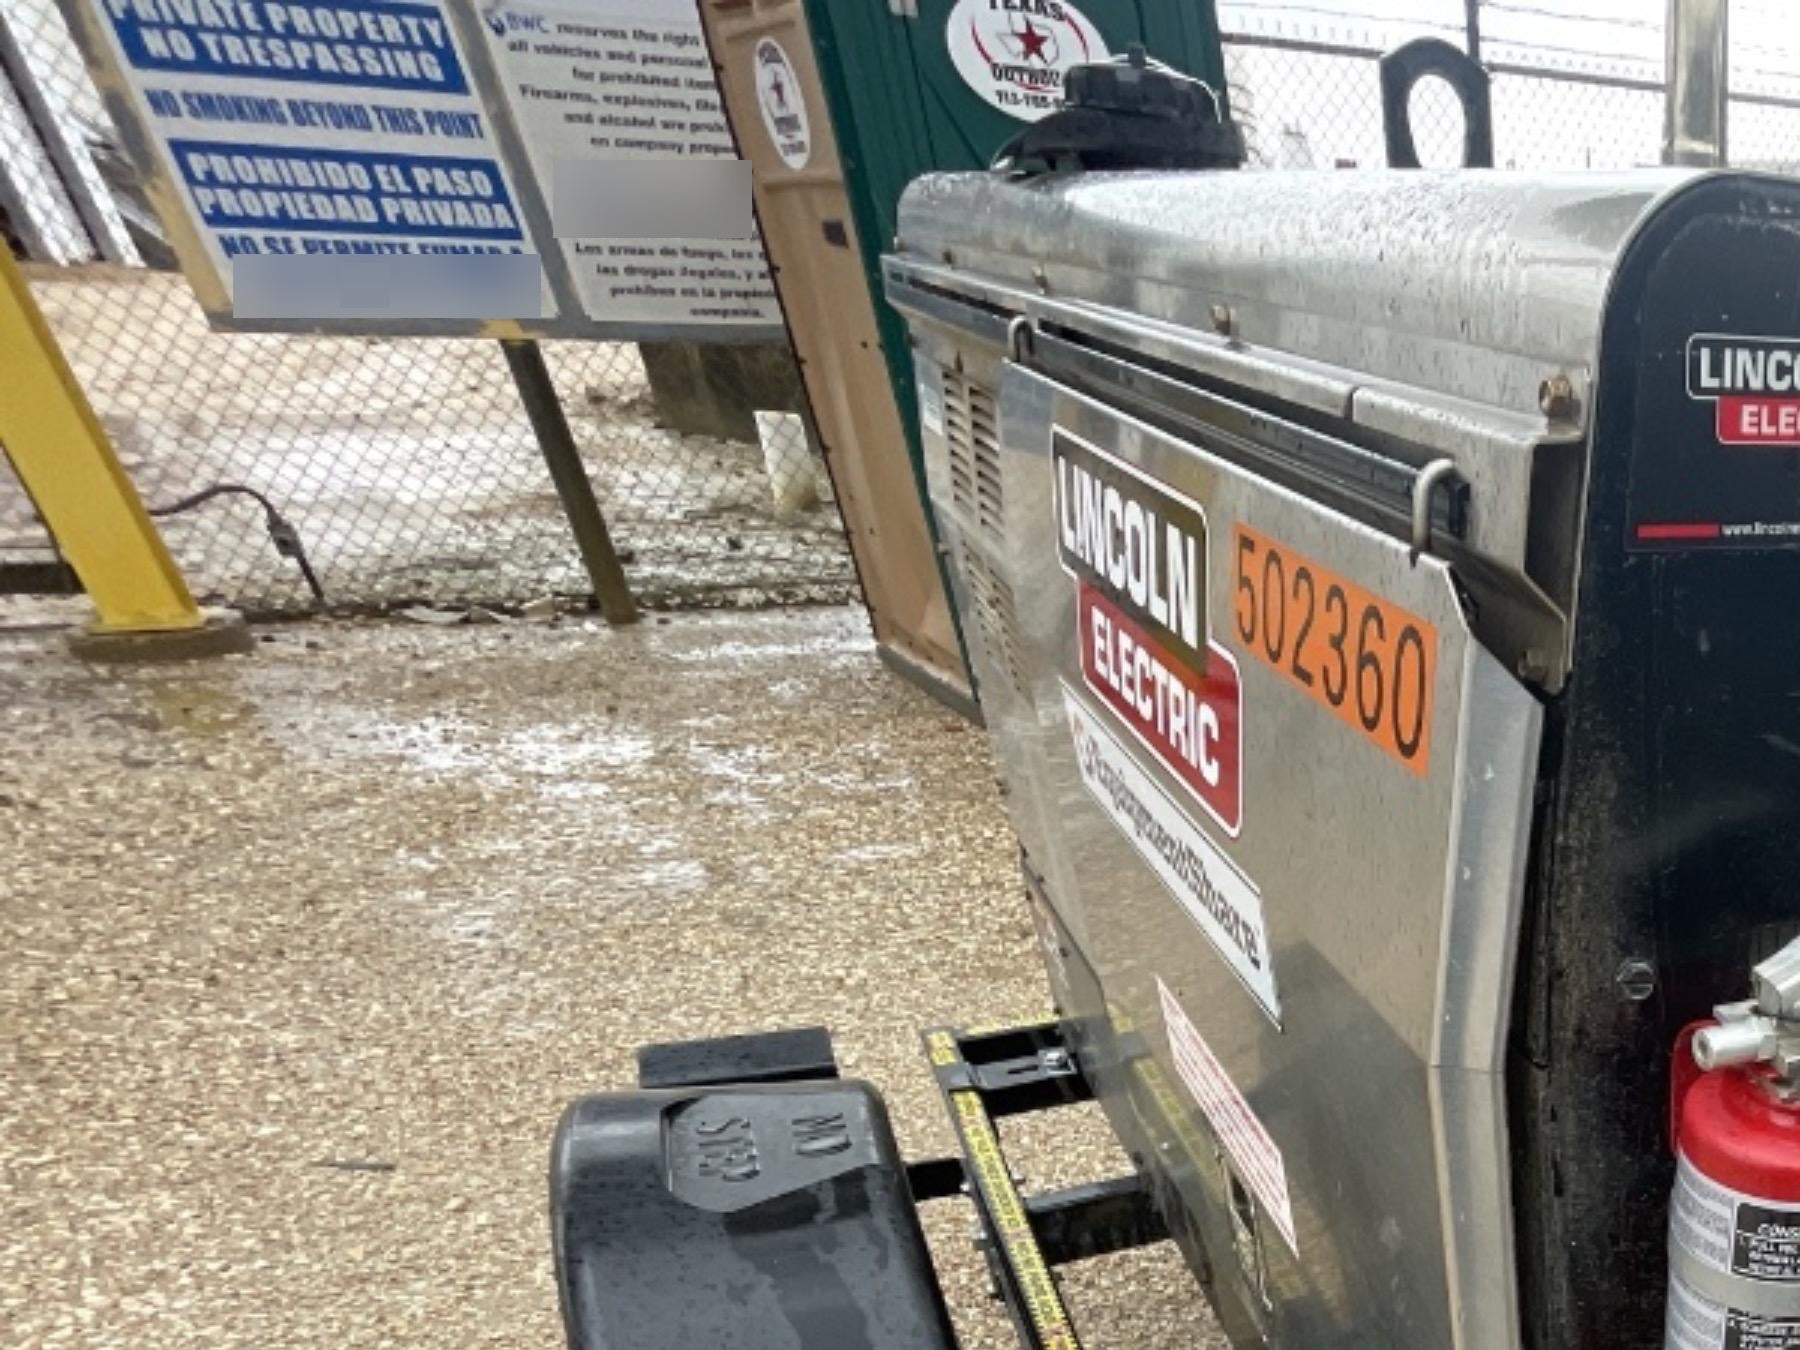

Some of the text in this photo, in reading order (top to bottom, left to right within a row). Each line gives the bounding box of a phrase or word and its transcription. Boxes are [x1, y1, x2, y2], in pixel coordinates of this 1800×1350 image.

[104, 0, 444, 48] PRIVATE PROPERTY
[139, 27, 444, 82] NO TRESPASSING
[144, 89, 484, 138] NO SMOKING BEYOND THIS POINT
[186, 153, 492, 197] PROHIBIDO EL PASO
[194, 187, 515, 228] PROPIEDAD PRIVADA
[1058, 455, 1197, 649] LINCOLN
[1237, 534, 1425, 758] 502360
[1091, 605, 1218, 786] ELECTRIC
